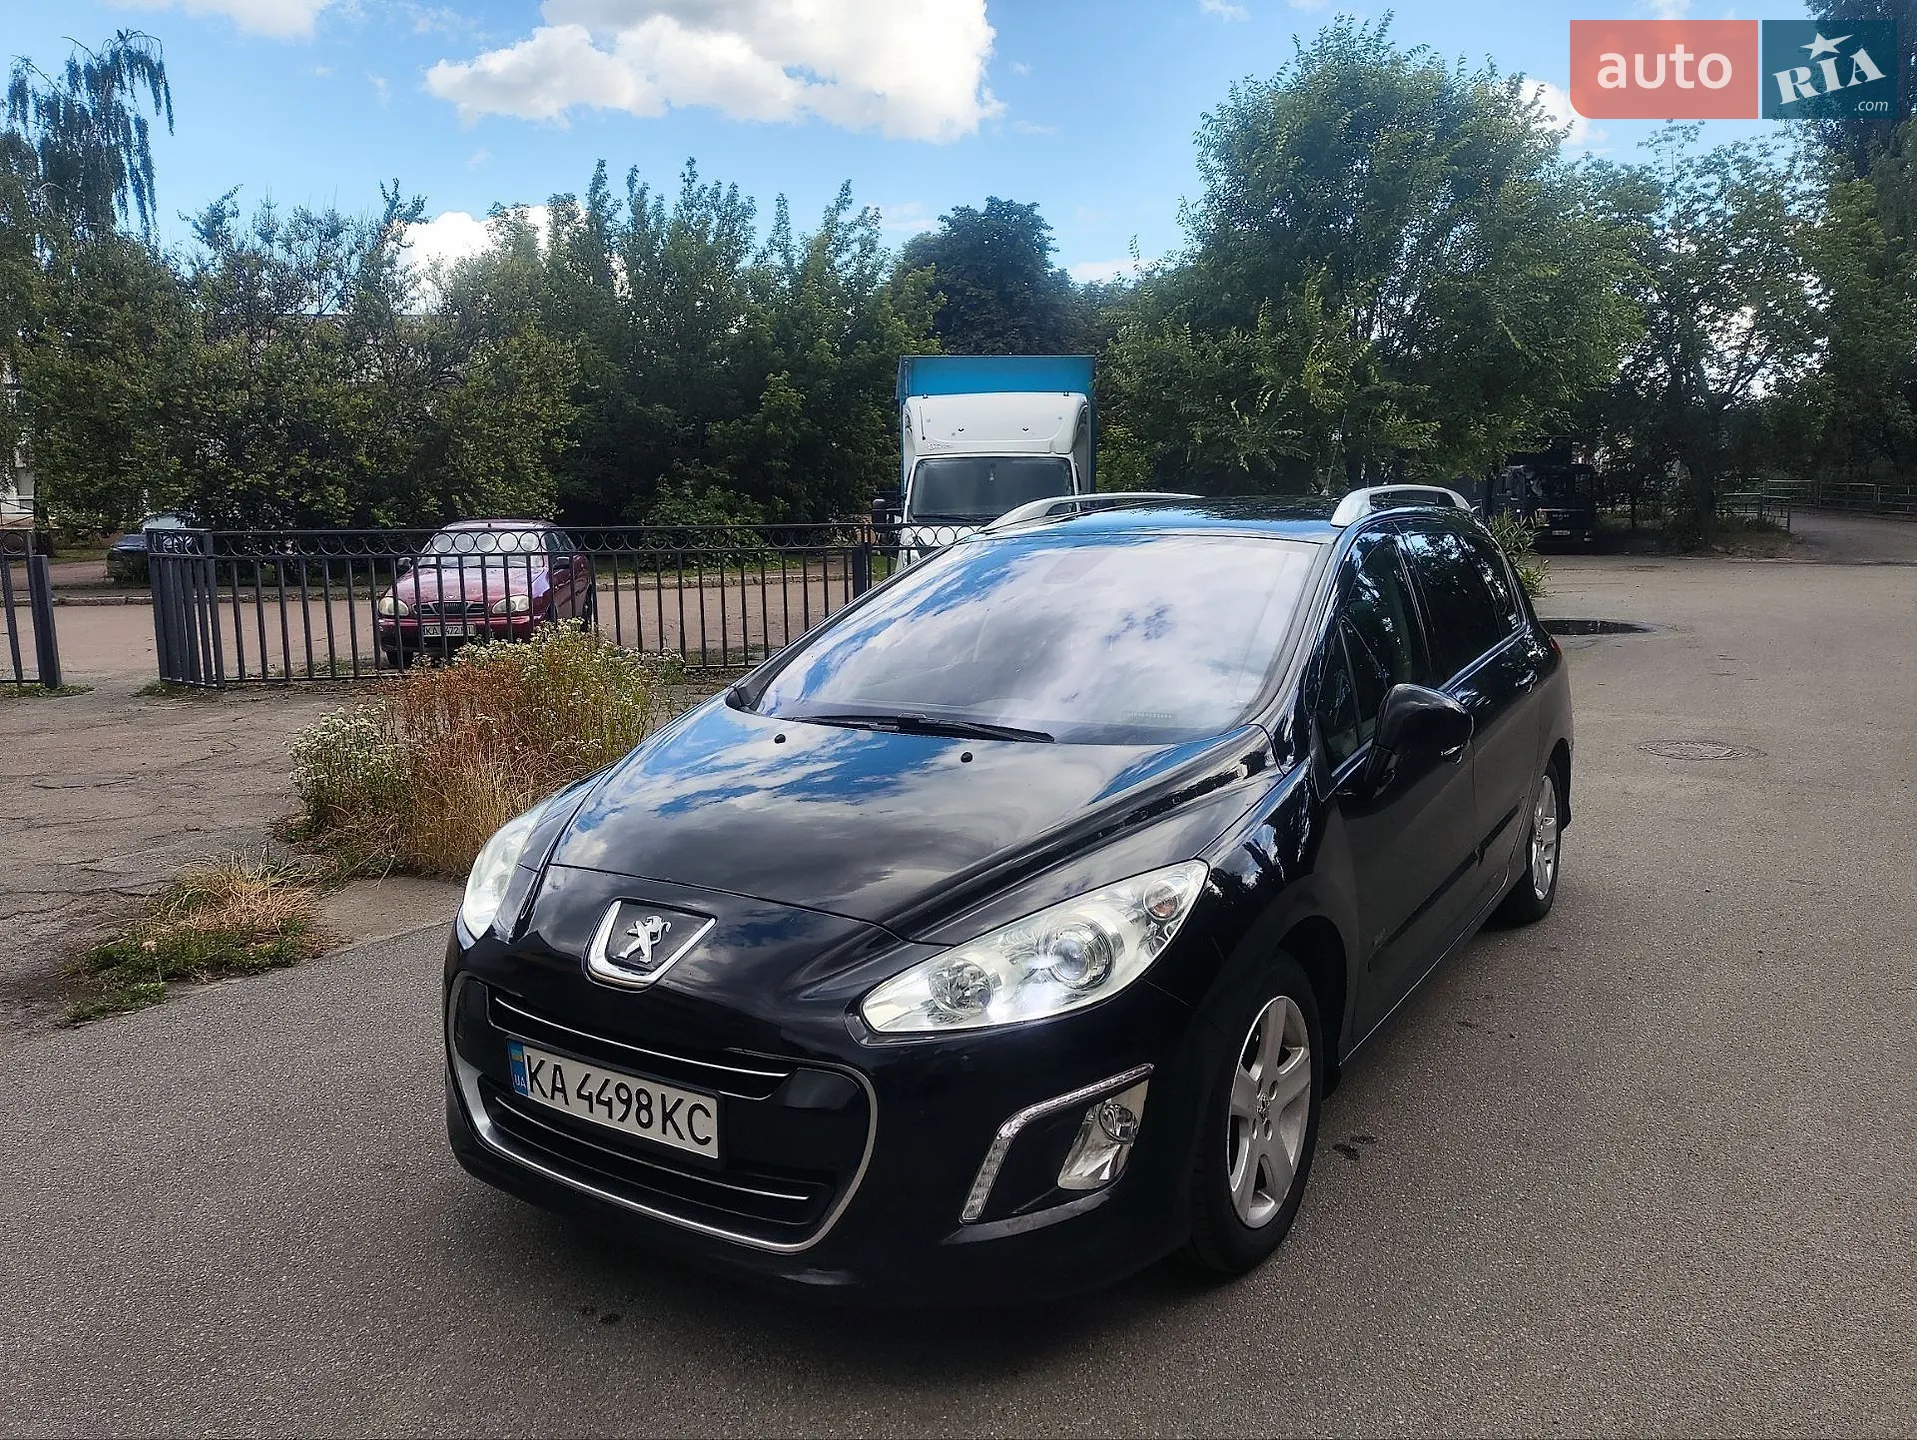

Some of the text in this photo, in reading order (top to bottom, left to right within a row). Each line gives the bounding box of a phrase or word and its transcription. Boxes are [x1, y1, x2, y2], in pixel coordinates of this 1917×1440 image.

[514, 1074, 527, 1089] UA
[526, 1054, 713, 1146] KA 4498 KC
